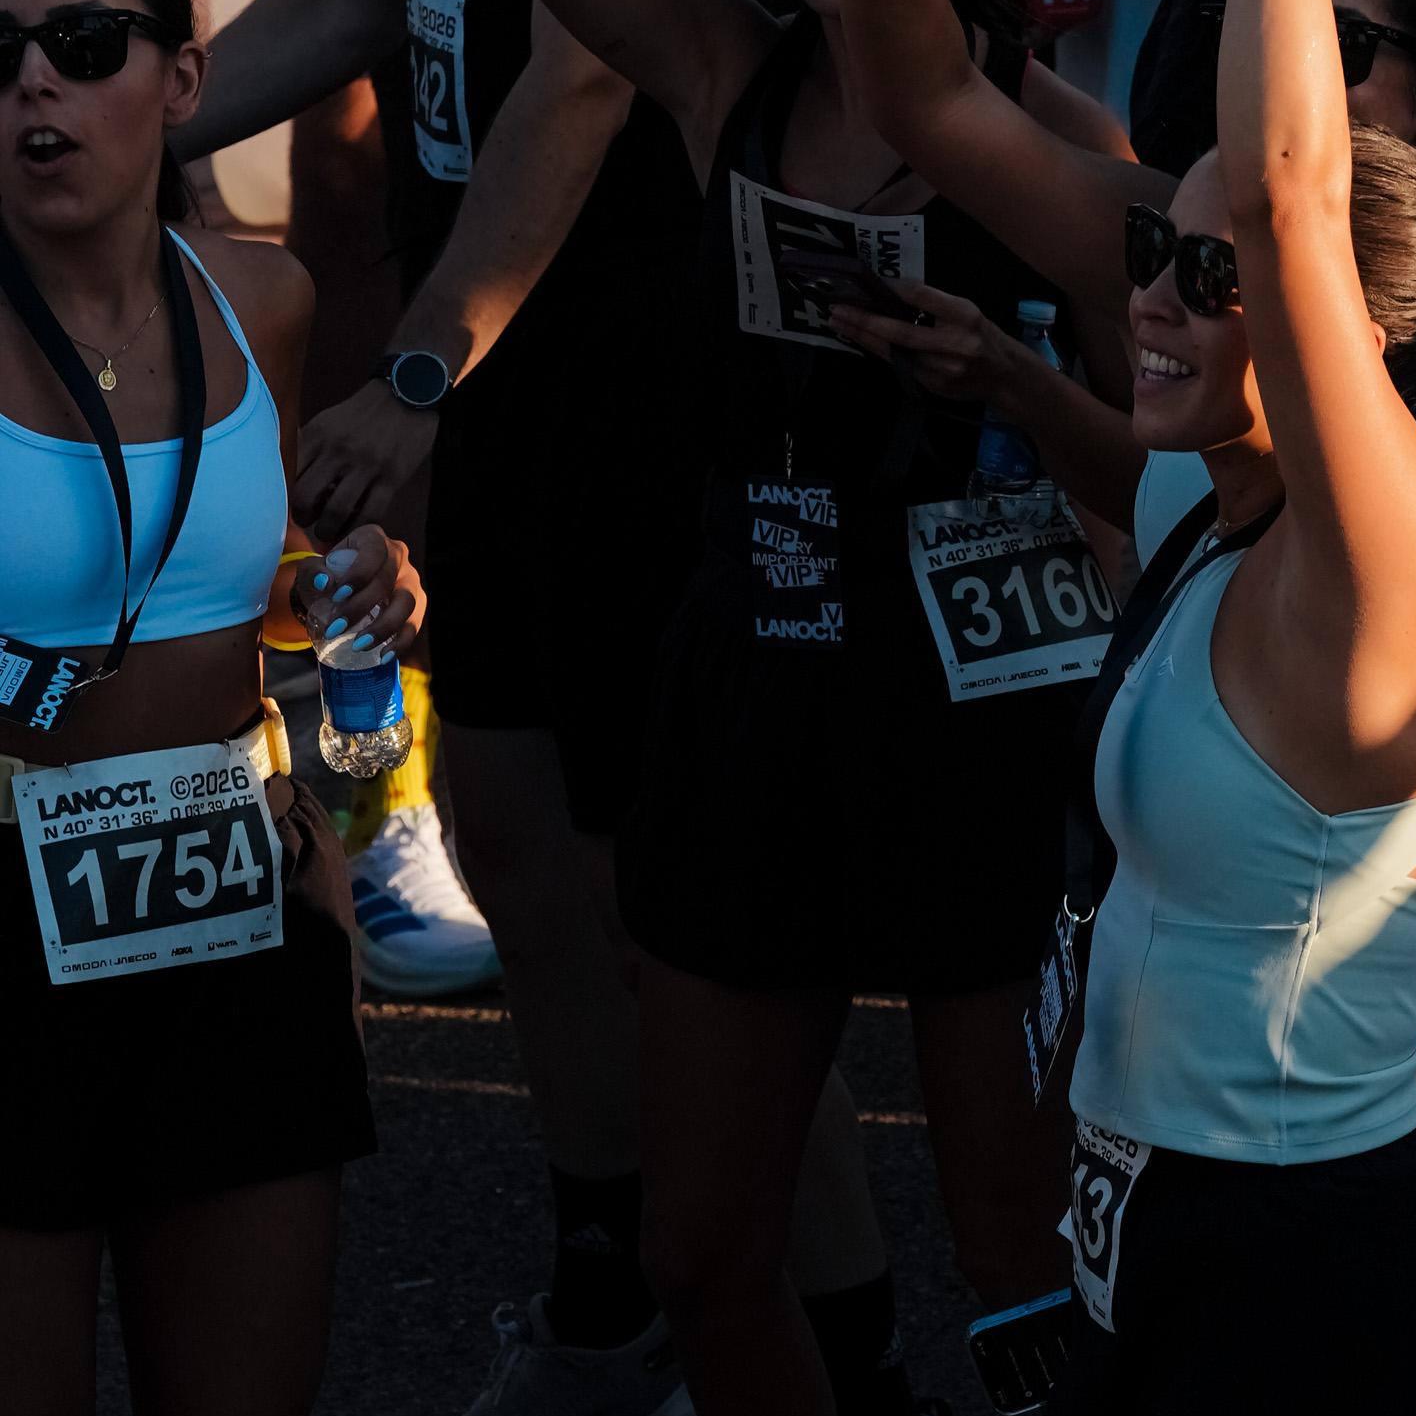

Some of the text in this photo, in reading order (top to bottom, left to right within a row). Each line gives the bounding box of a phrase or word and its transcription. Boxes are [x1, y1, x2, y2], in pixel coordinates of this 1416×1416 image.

[418, 6, 456, 38] 2026
[758, 520, 795, 547] VIP
[919, 519, 1019, 551] LANOCT.
[752, 552, 838, 572] IMPORTANT
[773, 564, 813, 585] VIP
[951, 551, 1114, 648] 3160
[755, 616, 842, 642] LANOCT.
[29, 657, 80, 731] LANOCT.
[37, 766, 250, 822] LANOCT. ©2026
[44, 826, 58, 840] N
[66, 819, 265, 928] 1754
